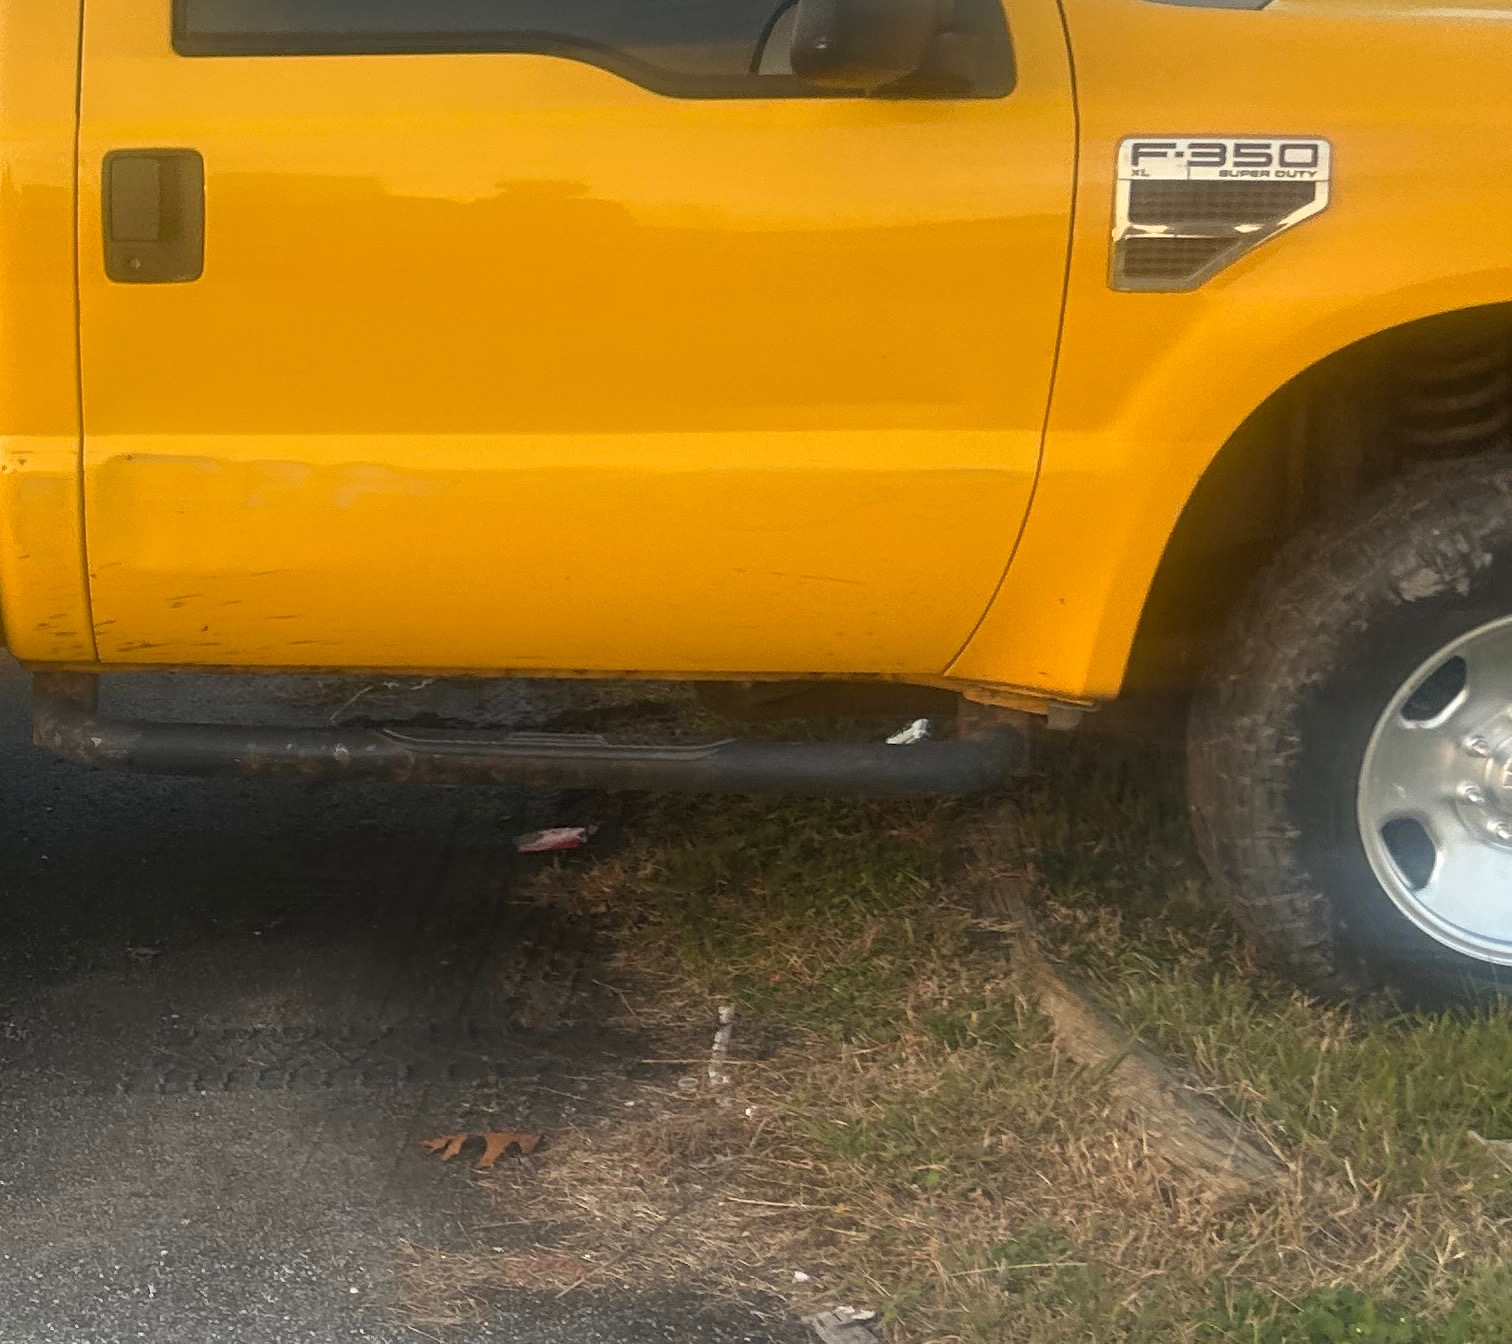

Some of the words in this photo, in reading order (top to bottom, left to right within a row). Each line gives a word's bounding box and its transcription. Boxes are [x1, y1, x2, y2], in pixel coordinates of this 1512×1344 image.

[1130, 142, 1319, 168] F-350
[1219, 169, 1270, 177] SUPER
[1275, 169, 1319, 178] DUTY
